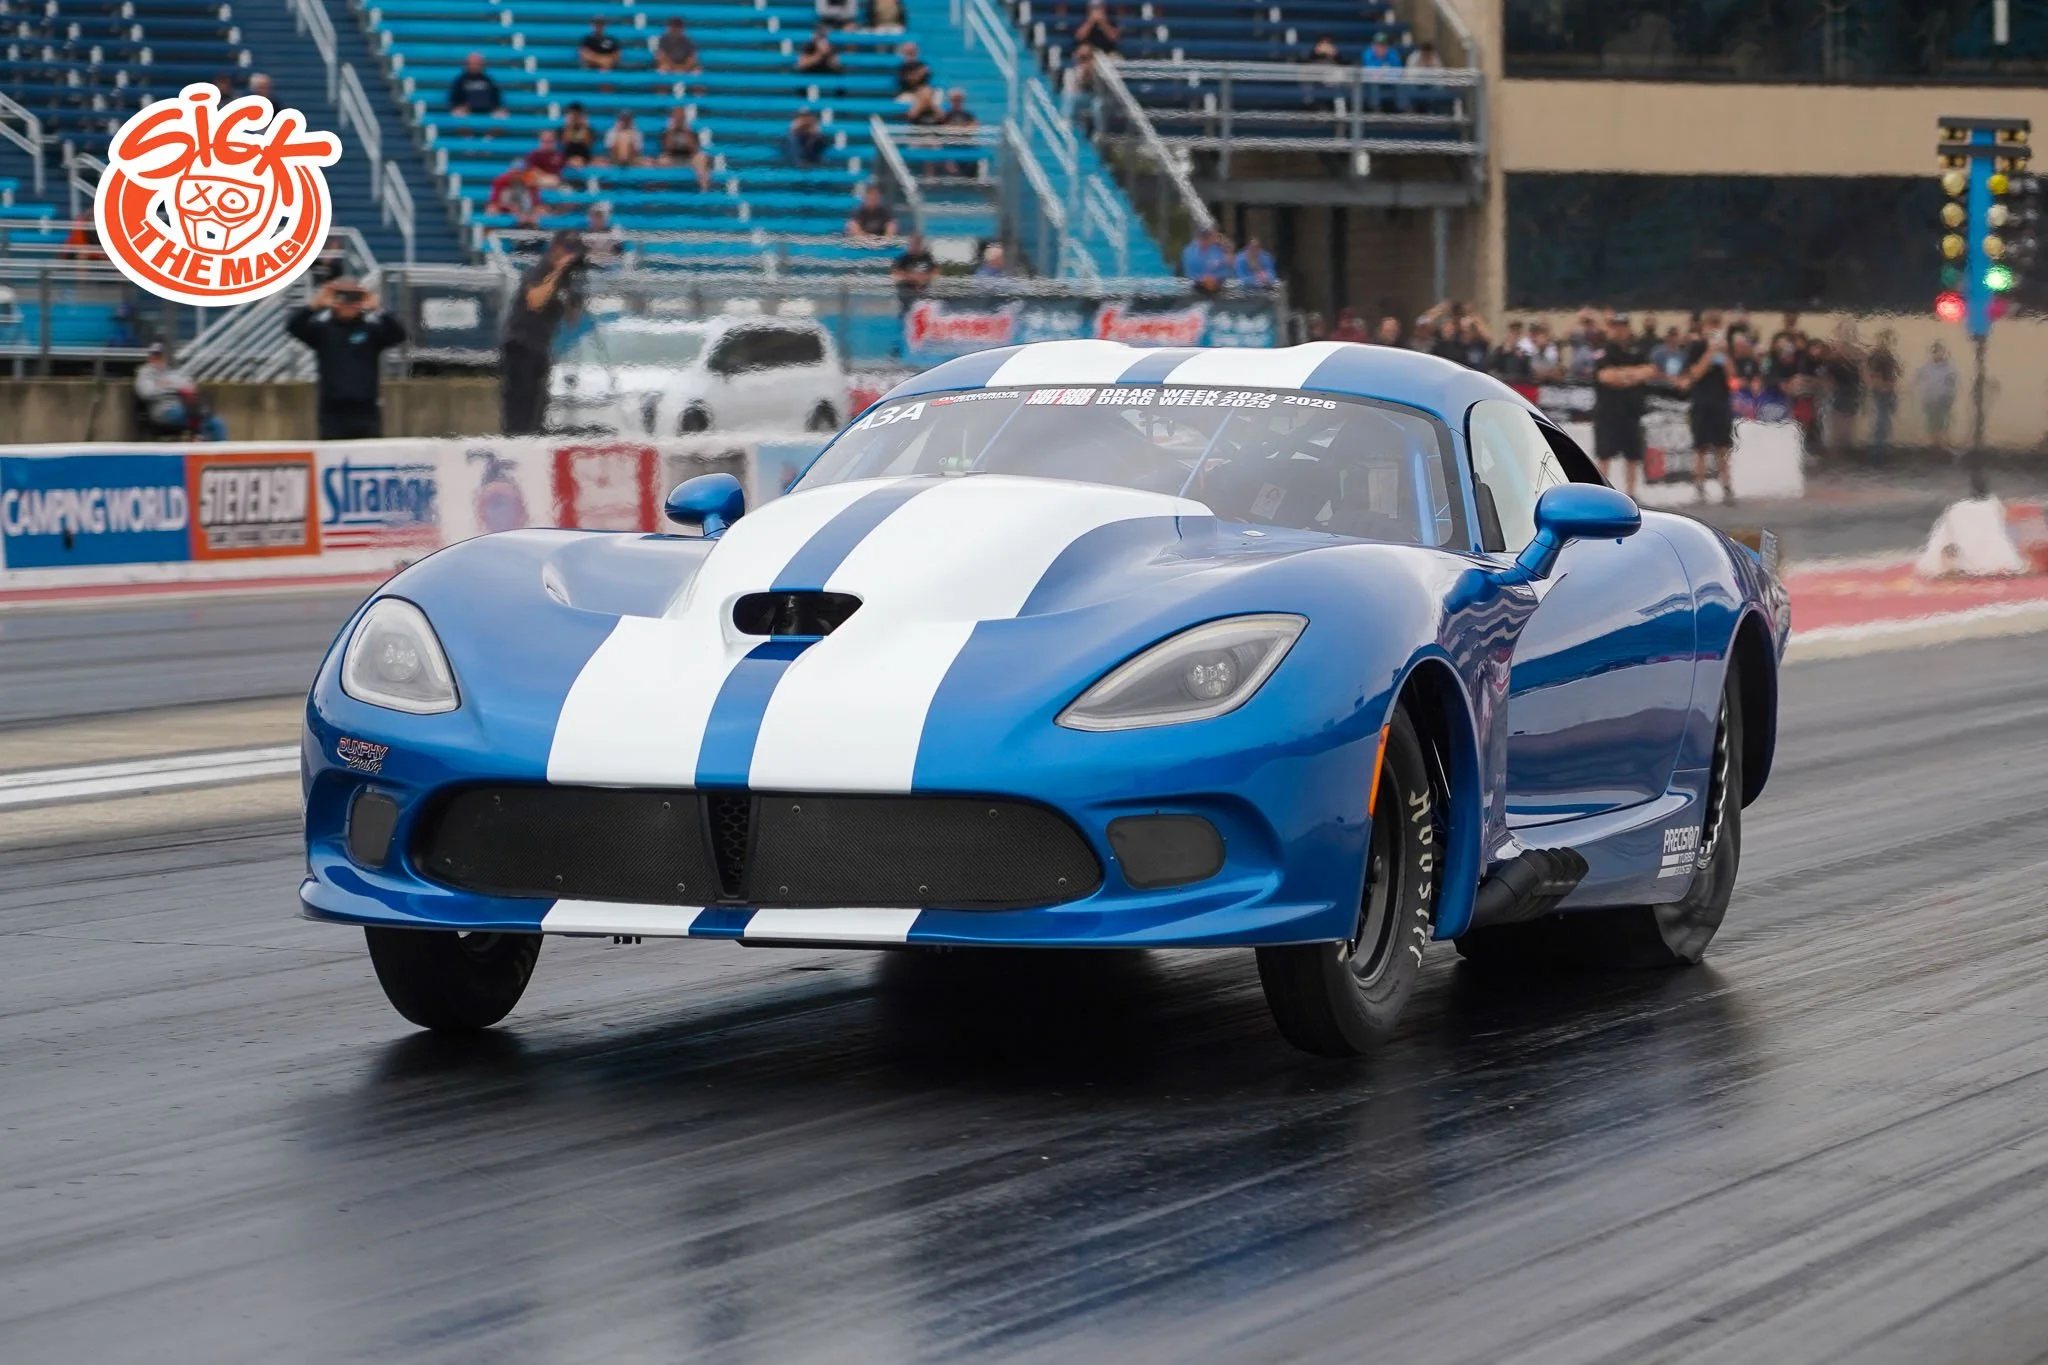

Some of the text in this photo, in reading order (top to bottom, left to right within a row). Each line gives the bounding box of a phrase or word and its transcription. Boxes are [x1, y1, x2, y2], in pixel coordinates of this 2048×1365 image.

[1100, 388, 1157, 398] DRAG
[1162, 388, 1223, 399] WEEK
[1224, 390, 1278, 402] 2024
[1095, 396, 1153, 406] DRAG
[1158, 397, 1215, 406] WEEK
[1217, 398, 1272, 409] 2025
[1282, 395, 1337, 410] 2026
[2, 485, 188, 536] CAMPING WORLD
